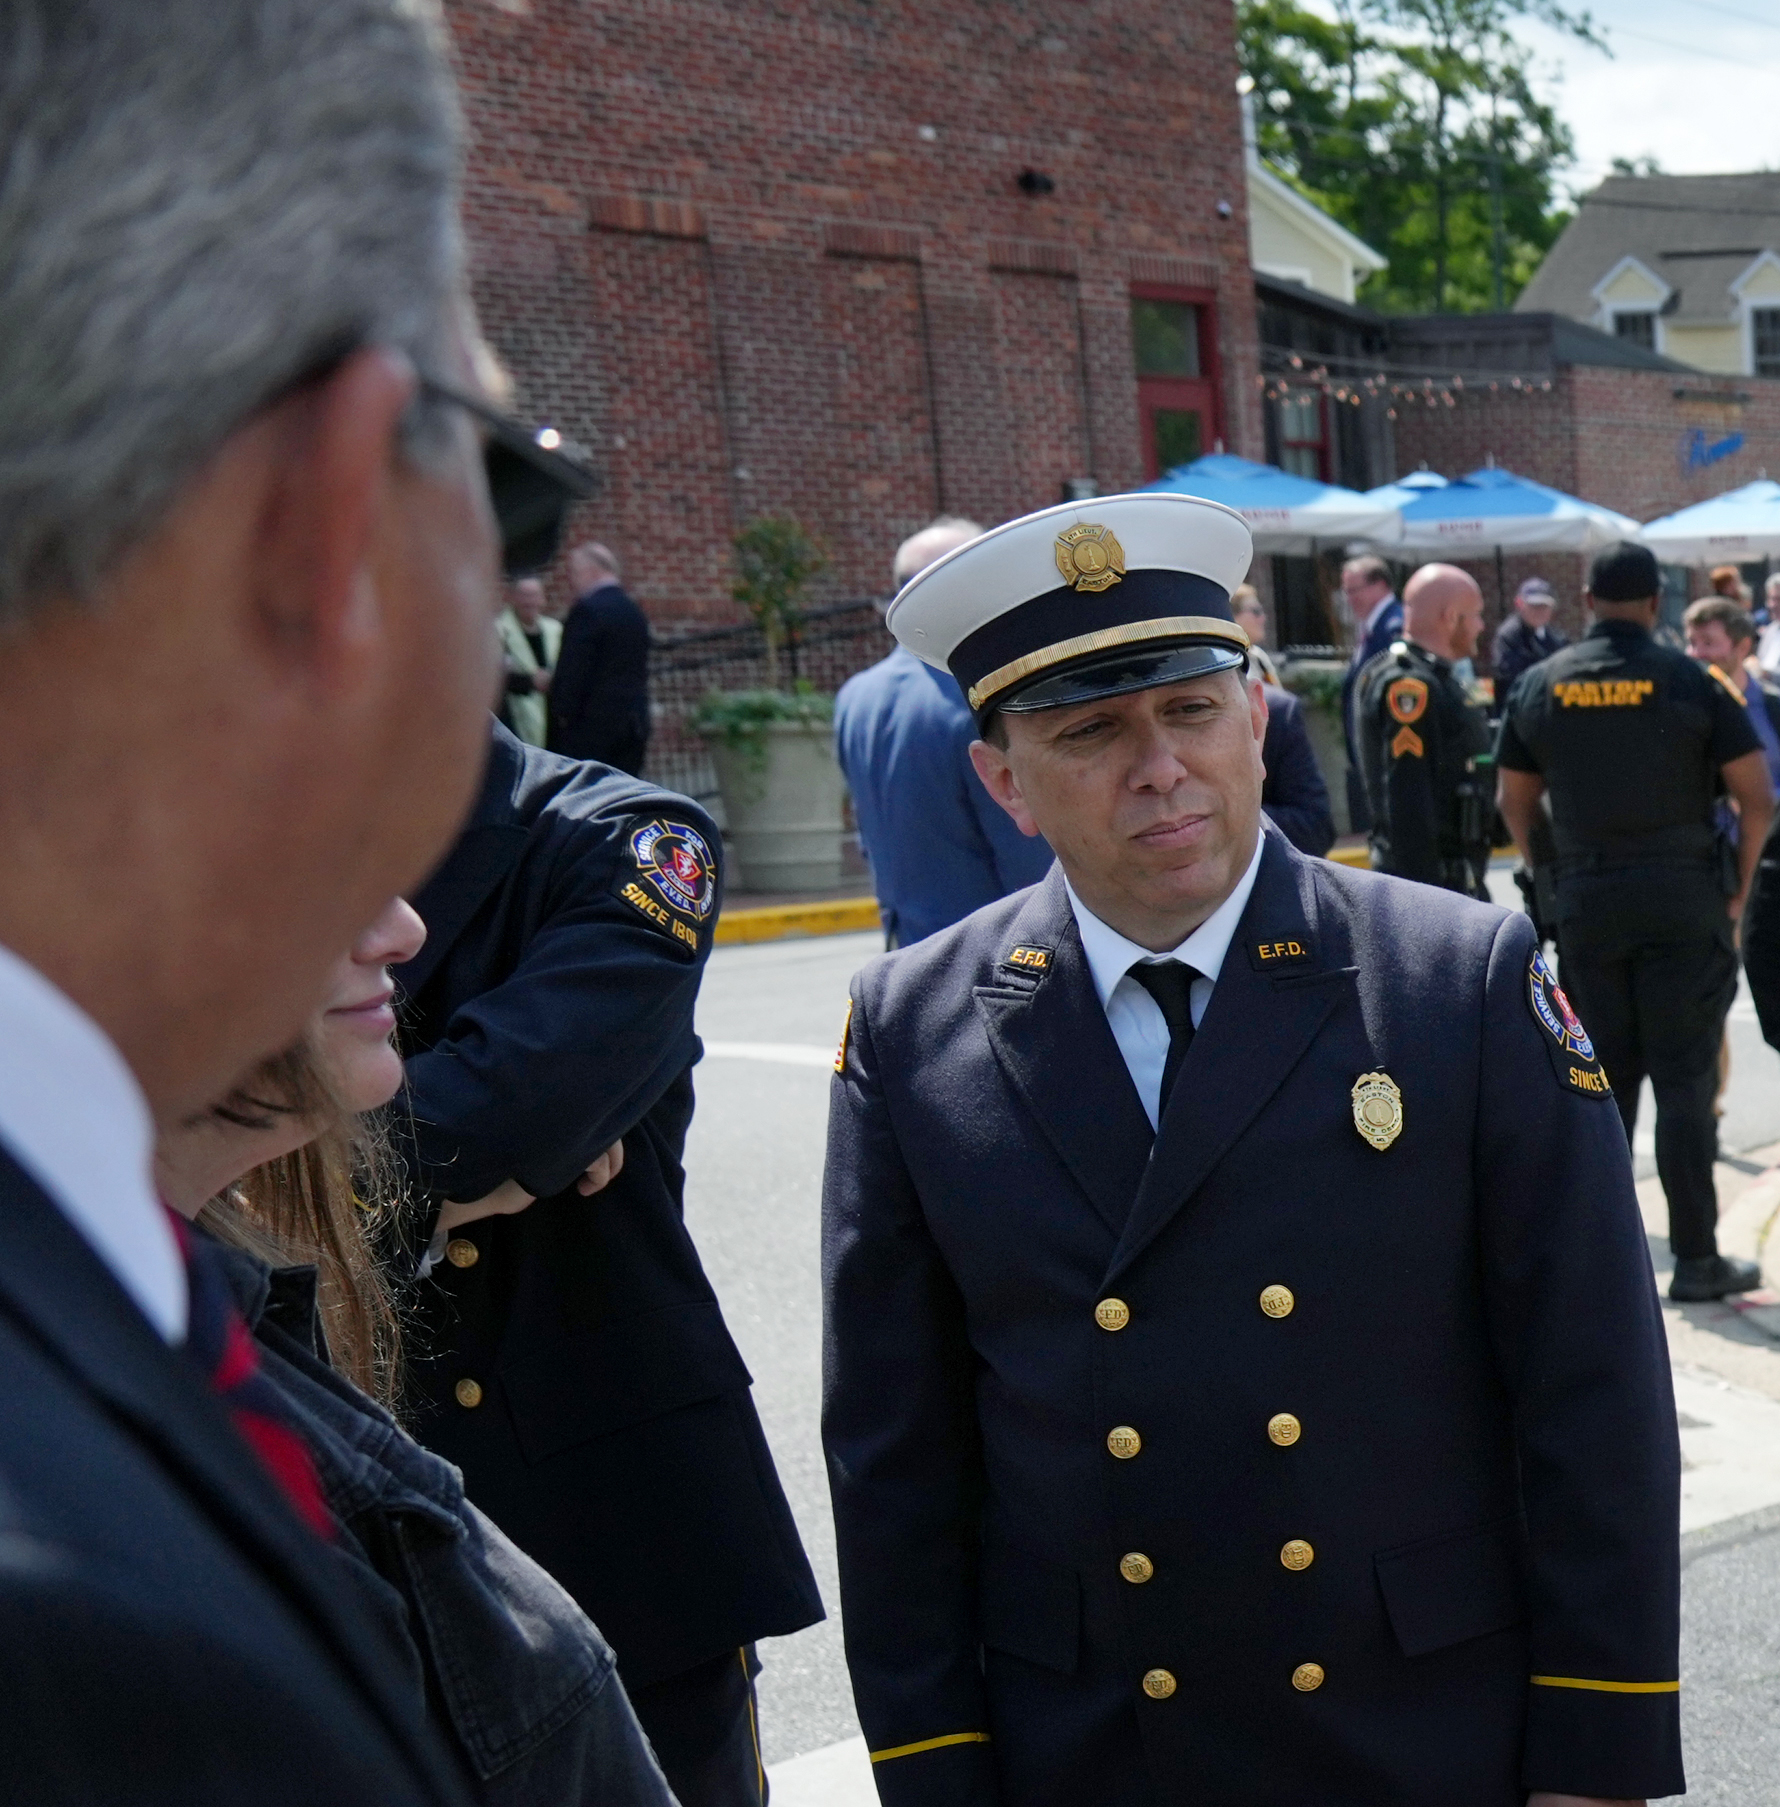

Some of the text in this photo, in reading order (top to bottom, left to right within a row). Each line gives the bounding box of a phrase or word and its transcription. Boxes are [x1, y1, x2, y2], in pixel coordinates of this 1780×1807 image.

[1554, 680, 1653, 697] EASTON
[684, 830, 704, 850] FOR
[621, 882, 670, 926] SINCE
[1010, 948, 1047, 968] E.F.D.
[1258, 941, 1306, 959] E.F.D.
[1533, 984, 1559, 1035] SERVICE
[1569, 1066, 1601, 1092] SINCE
[1360, 1092, 1394, 1104] EASTON
